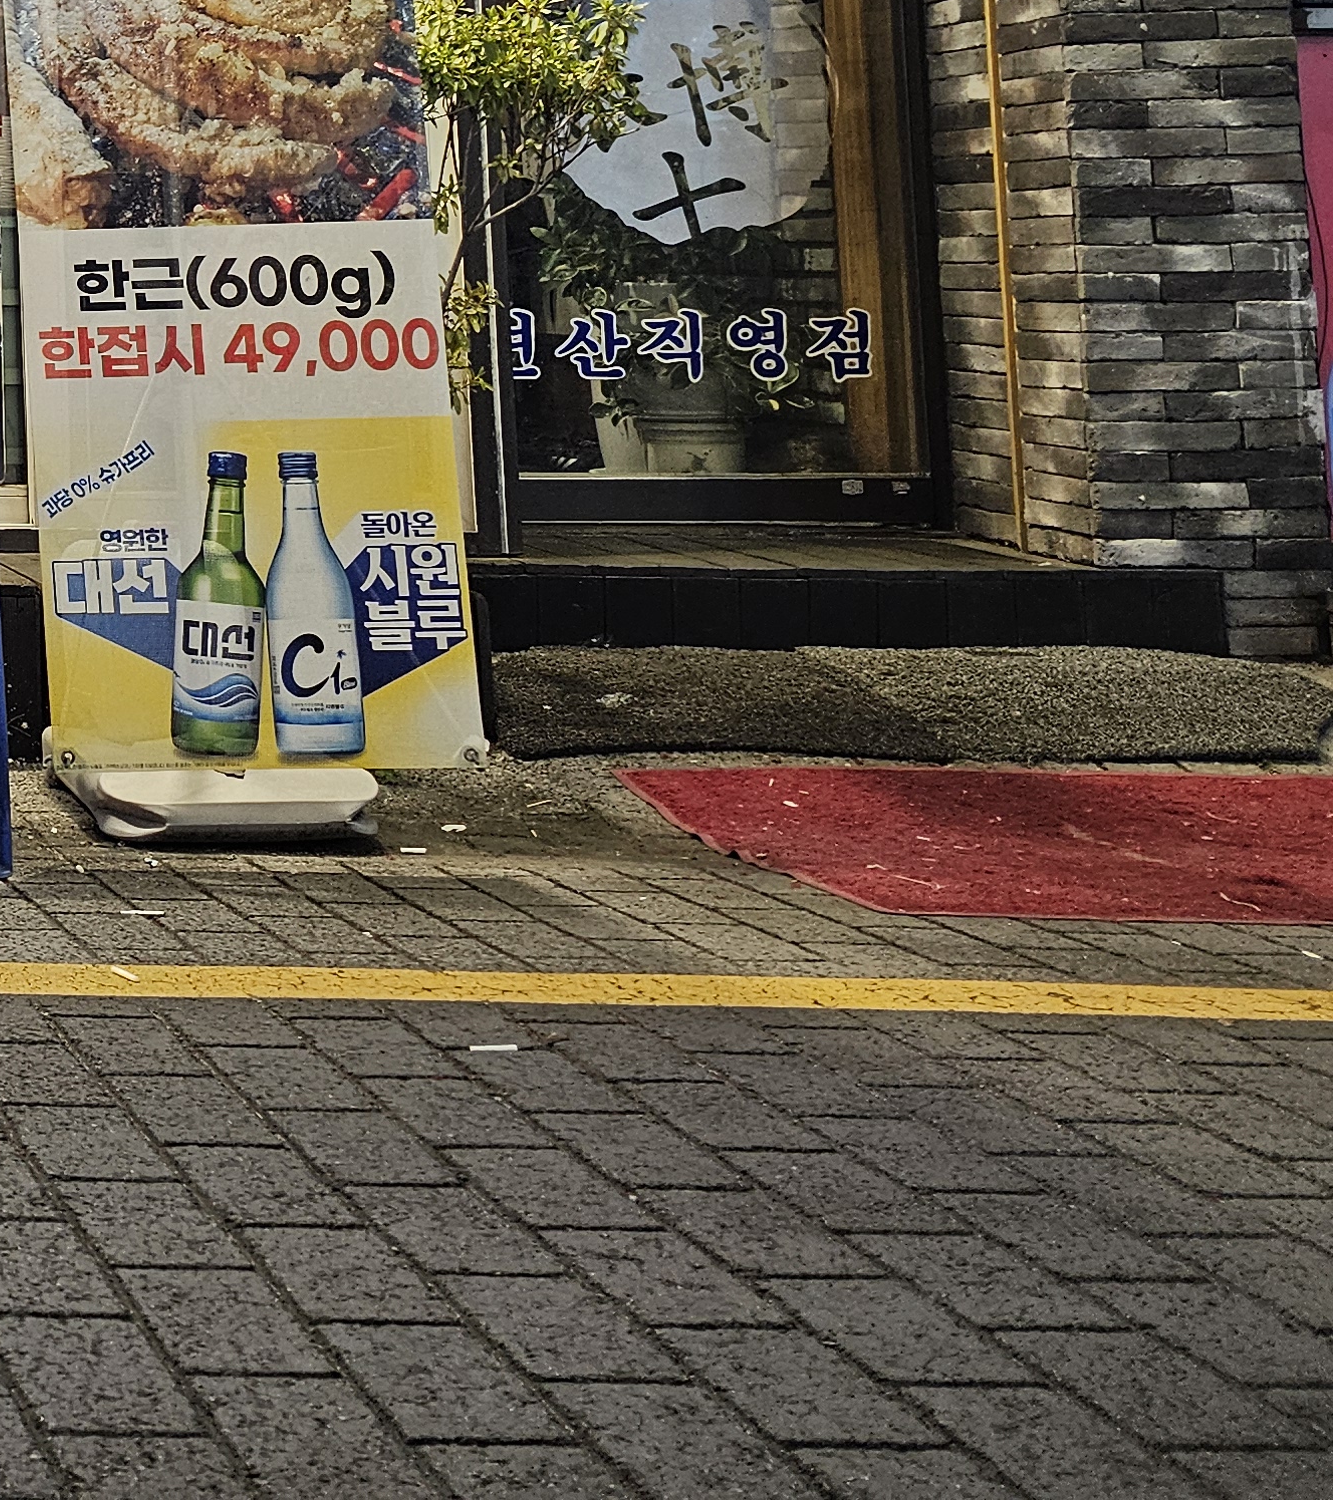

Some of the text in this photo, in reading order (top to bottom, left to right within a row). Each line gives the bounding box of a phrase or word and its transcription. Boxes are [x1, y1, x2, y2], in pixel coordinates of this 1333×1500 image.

[73, 250, 396, 319] 한근(600g)
[38, 318, 440, 380] 한접시 49,000
[41, 440, 156, 519] 과당 0% 슈가프리
[99, 527, 169, 553] 영원한
[361, 510, 438, 538] 돌아온
[53, 558, 171, 615] 대선
[360, 543, 462, 598] 시원
[182, 619, 256, 661] 대선
[363, 601, 469, 652] 블루
